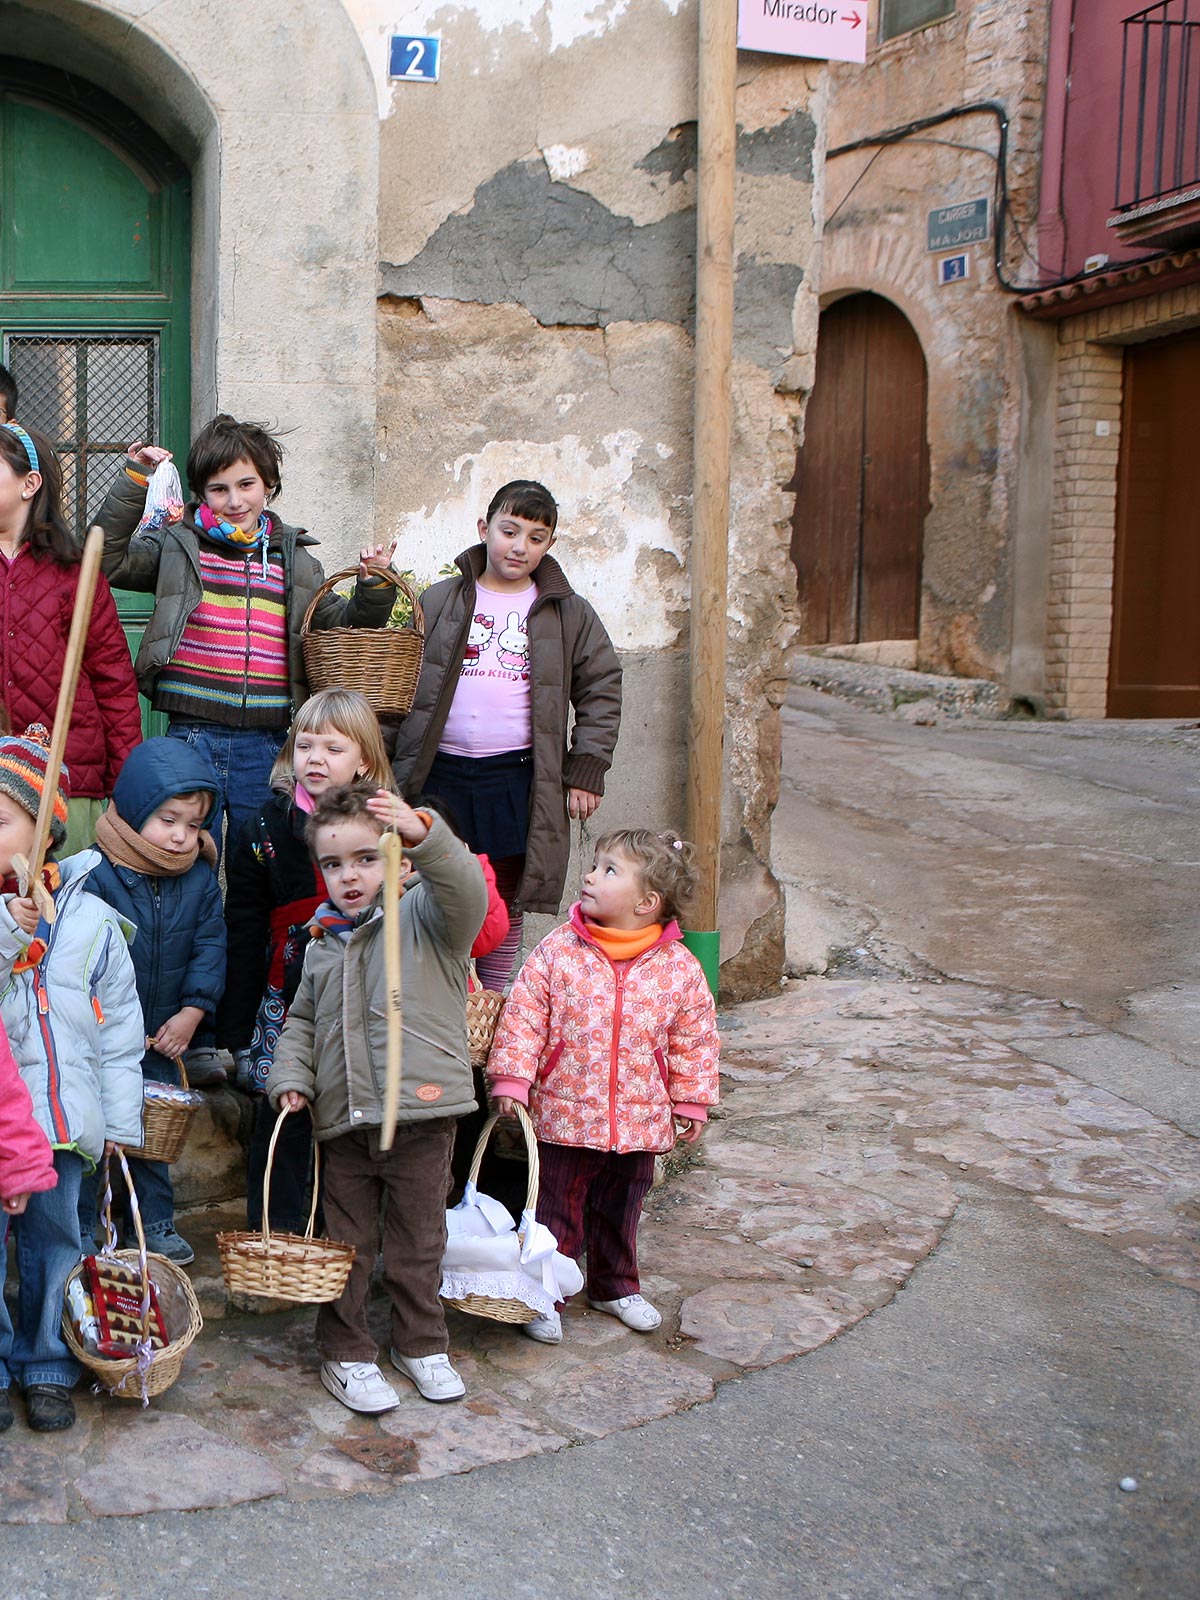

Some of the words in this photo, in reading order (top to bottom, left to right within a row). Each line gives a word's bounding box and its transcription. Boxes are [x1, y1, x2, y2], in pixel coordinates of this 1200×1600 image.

[763, 0, 837, 24] Mirador
[405, 40, 425, 75] 2
[938, 203, 976, 224] CARRER
[930, 227, 983, 248] MAJOR
[950, 260, 960, 280] 3
[487, 669, 519, 681] Kitty
